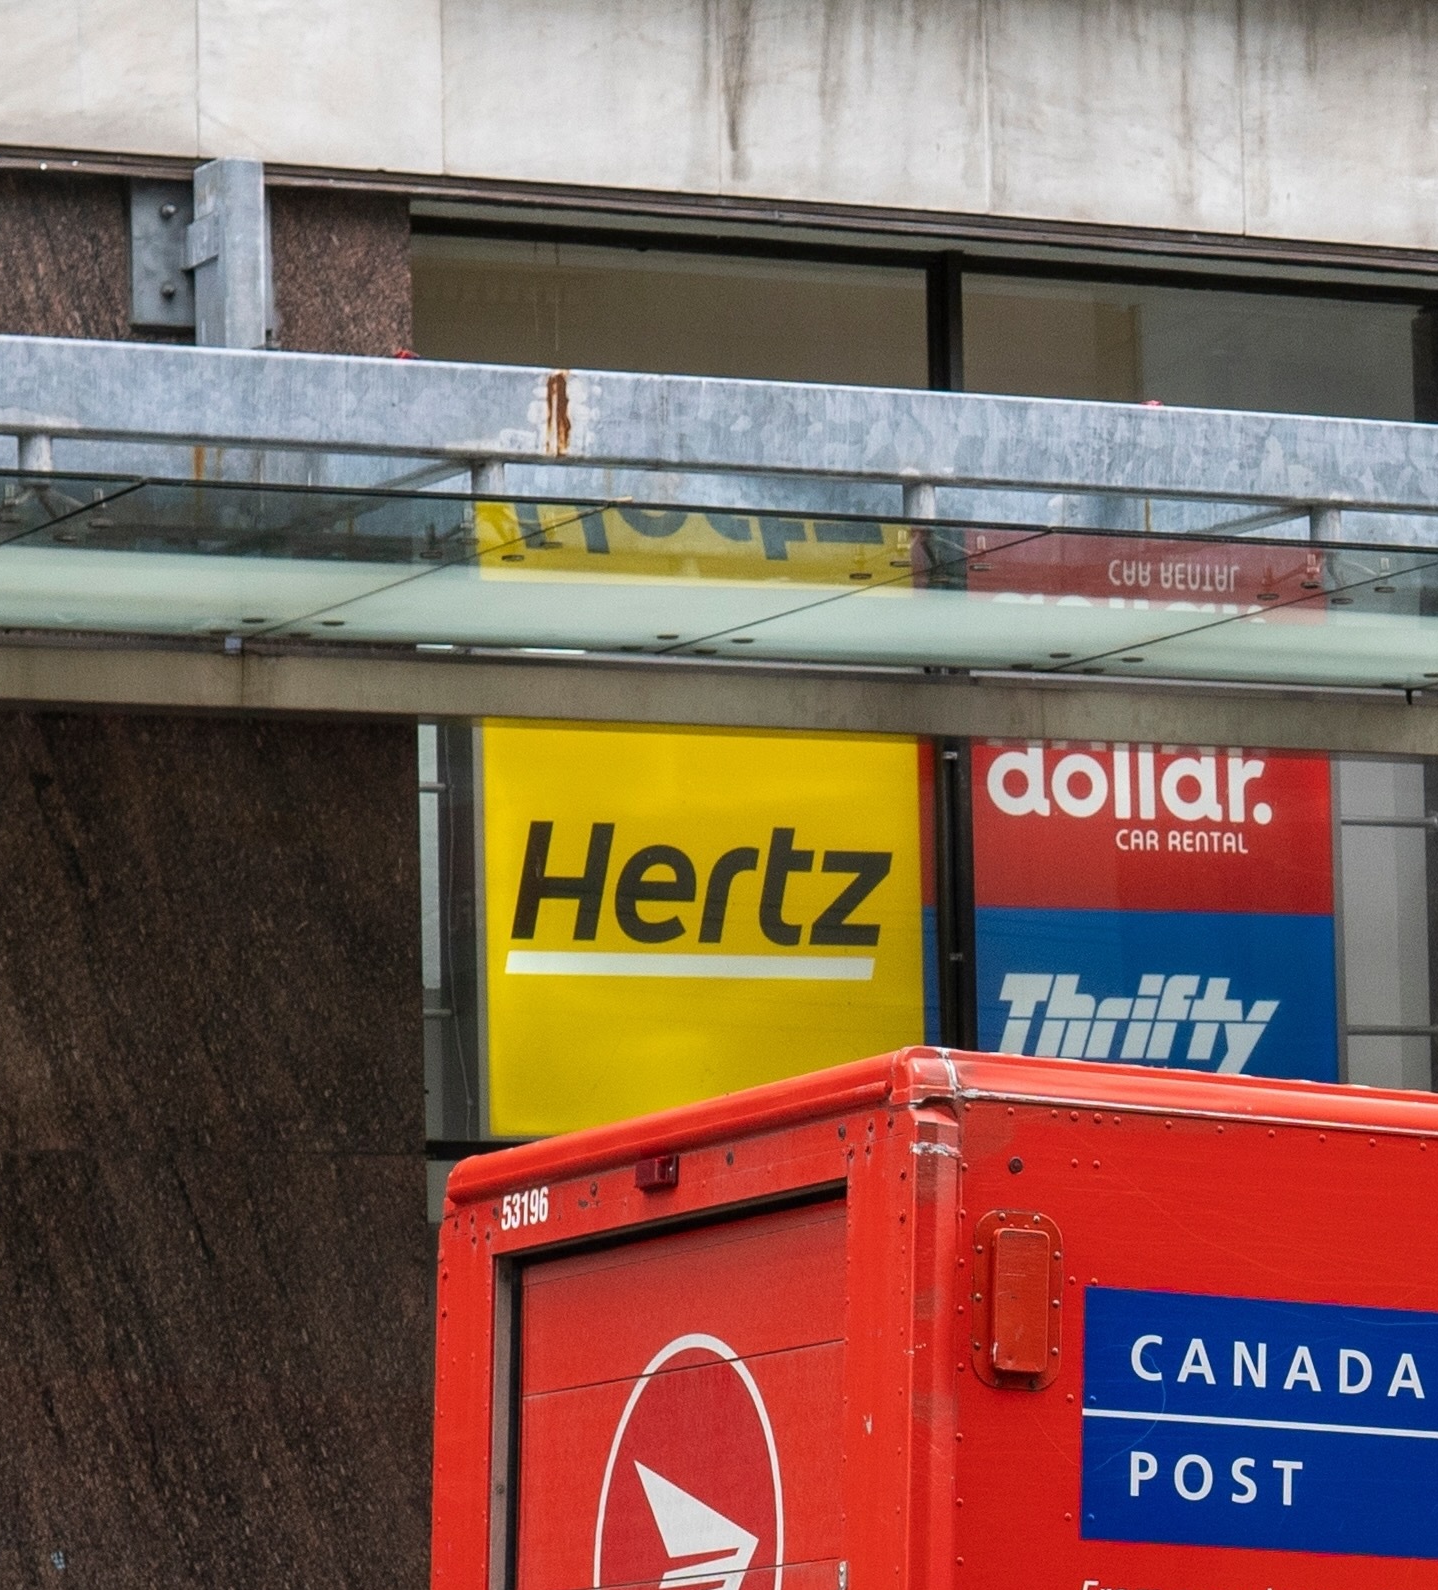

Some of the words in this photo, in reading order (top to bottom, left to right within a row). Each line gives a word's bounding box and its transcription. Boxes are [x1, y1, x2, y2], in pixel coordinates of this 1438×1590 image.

[986, 744, 1273, 826] dollar.
[1115, 829, 1160, 851] CAR
[1168, 830, 1249, 854] RENTAL
[510, 819, 894, 947] Hertz
[998, 973, 1281, 1075] Thrifty
[501, 1186, 549, 1231] 53196
[1130, 1334, 1426, 1400] CANADA
[1129, 1450, 1304, 1507] POST
